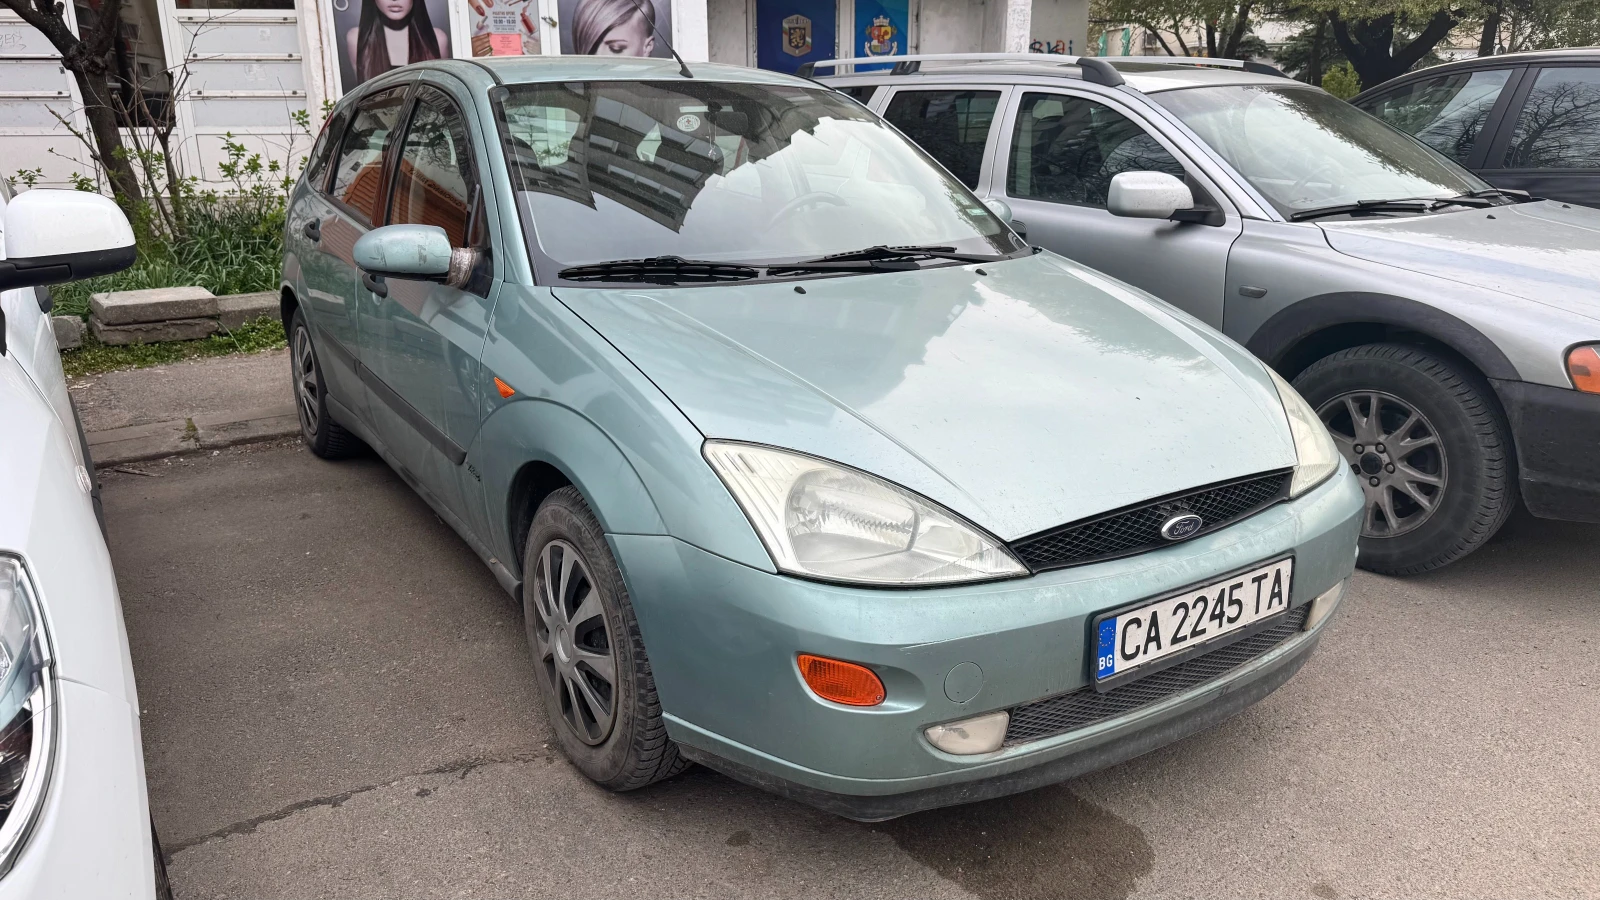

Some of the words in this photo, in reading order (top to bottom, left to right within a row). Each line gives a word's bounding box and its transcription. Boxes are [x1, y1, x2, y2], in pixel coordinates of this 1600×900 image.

[1173, 520, 1195, 535] Ford
[1120, 610, 1162, 661] CA
[1170, 581, 1244, 646] 2245
[1251, 568, 1283, 615] TA
[611, 615, 627, 662] EURO
[1098, 654, 1113, 671] BG
